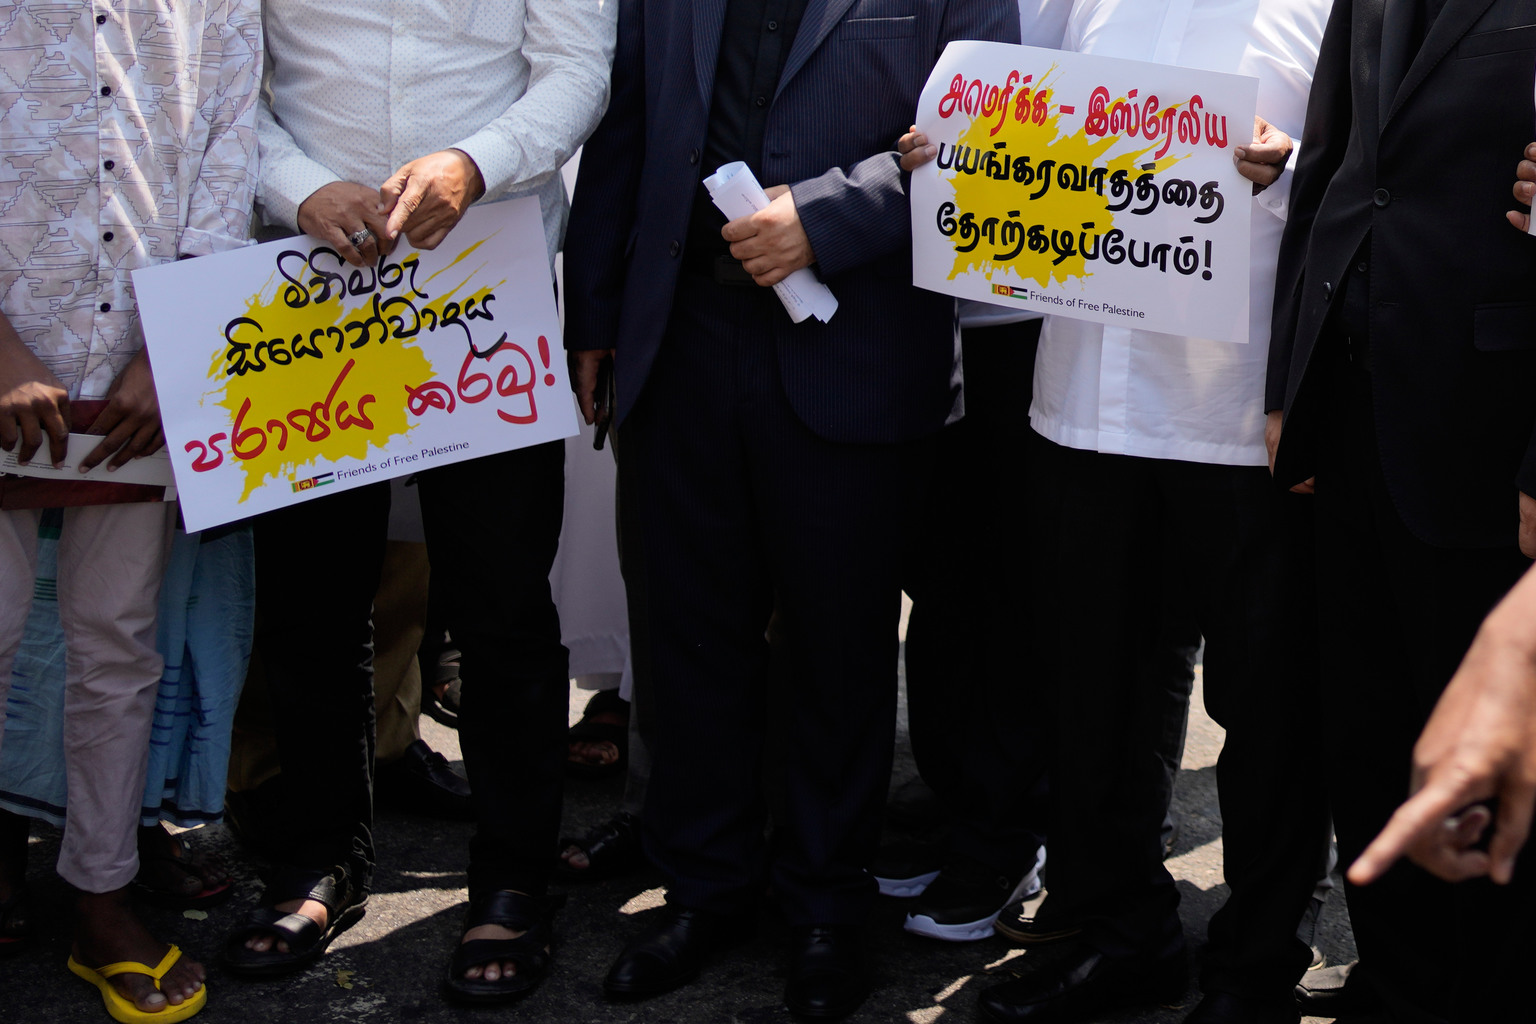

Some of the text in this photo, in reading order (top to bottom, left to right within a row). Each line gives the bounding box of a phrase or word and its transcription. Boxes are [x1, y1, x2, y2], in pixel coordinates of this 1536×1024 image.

[938, 70, 1048, 138] அமெரிக்க
[1084, 85, 1229, 160] இஸ்ரேலிய
[936, 141, 1225, 224] பயங்கரவாதத்தை
[1029, 290, 1146, 319] Friends of Free Palestine
[337, 440, 470, 480] Friends of Free Palestine
